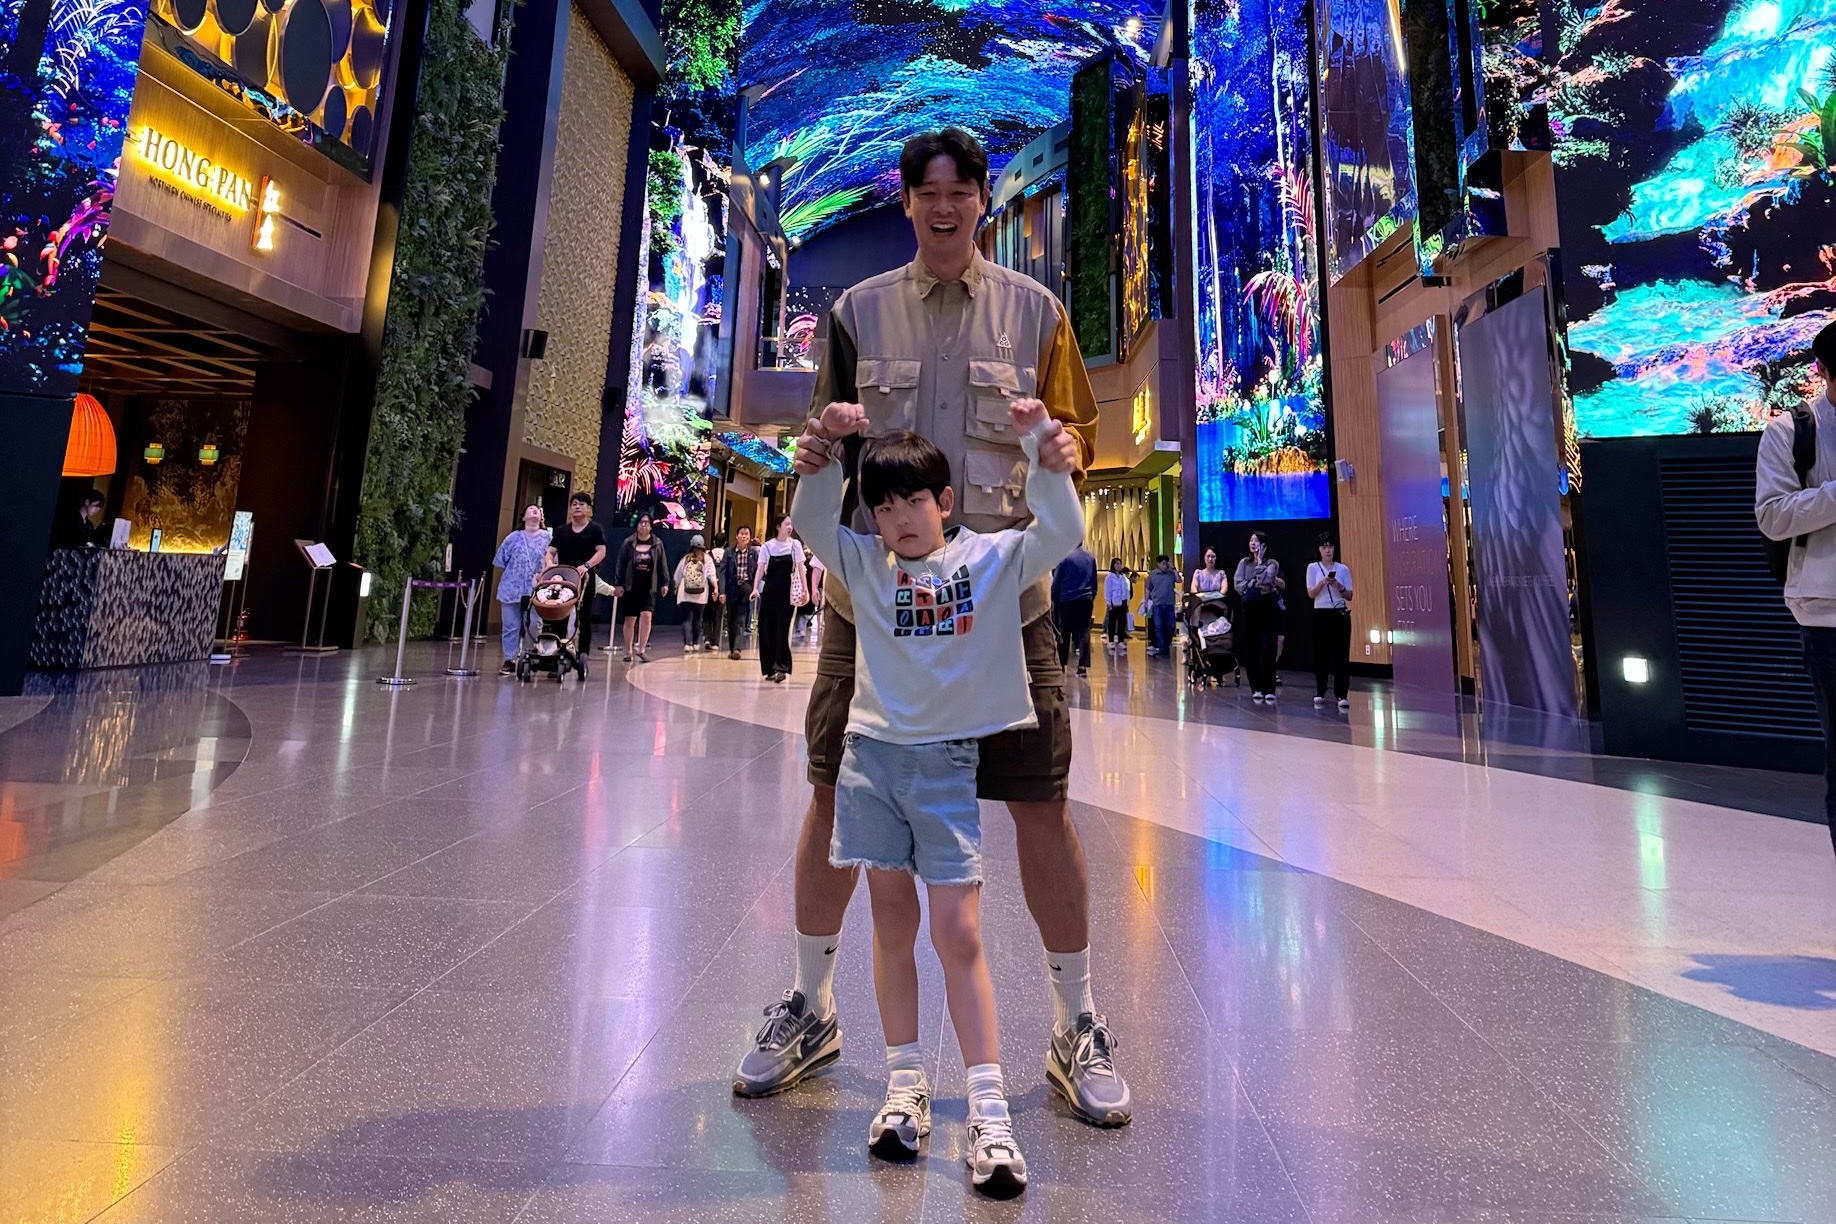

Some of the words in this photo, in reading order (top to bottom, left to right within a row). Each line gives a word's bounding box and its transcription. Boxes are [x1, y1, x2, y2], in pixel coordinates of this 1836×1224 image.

[144, 127, 211, 187] HONG
[216, 167, 254, 210] PAN
[1392, 515, 1419, 543] WHERE
[1395, 585, 1413, 611] SETS
[1413, 584, 1433, 612] YOU
